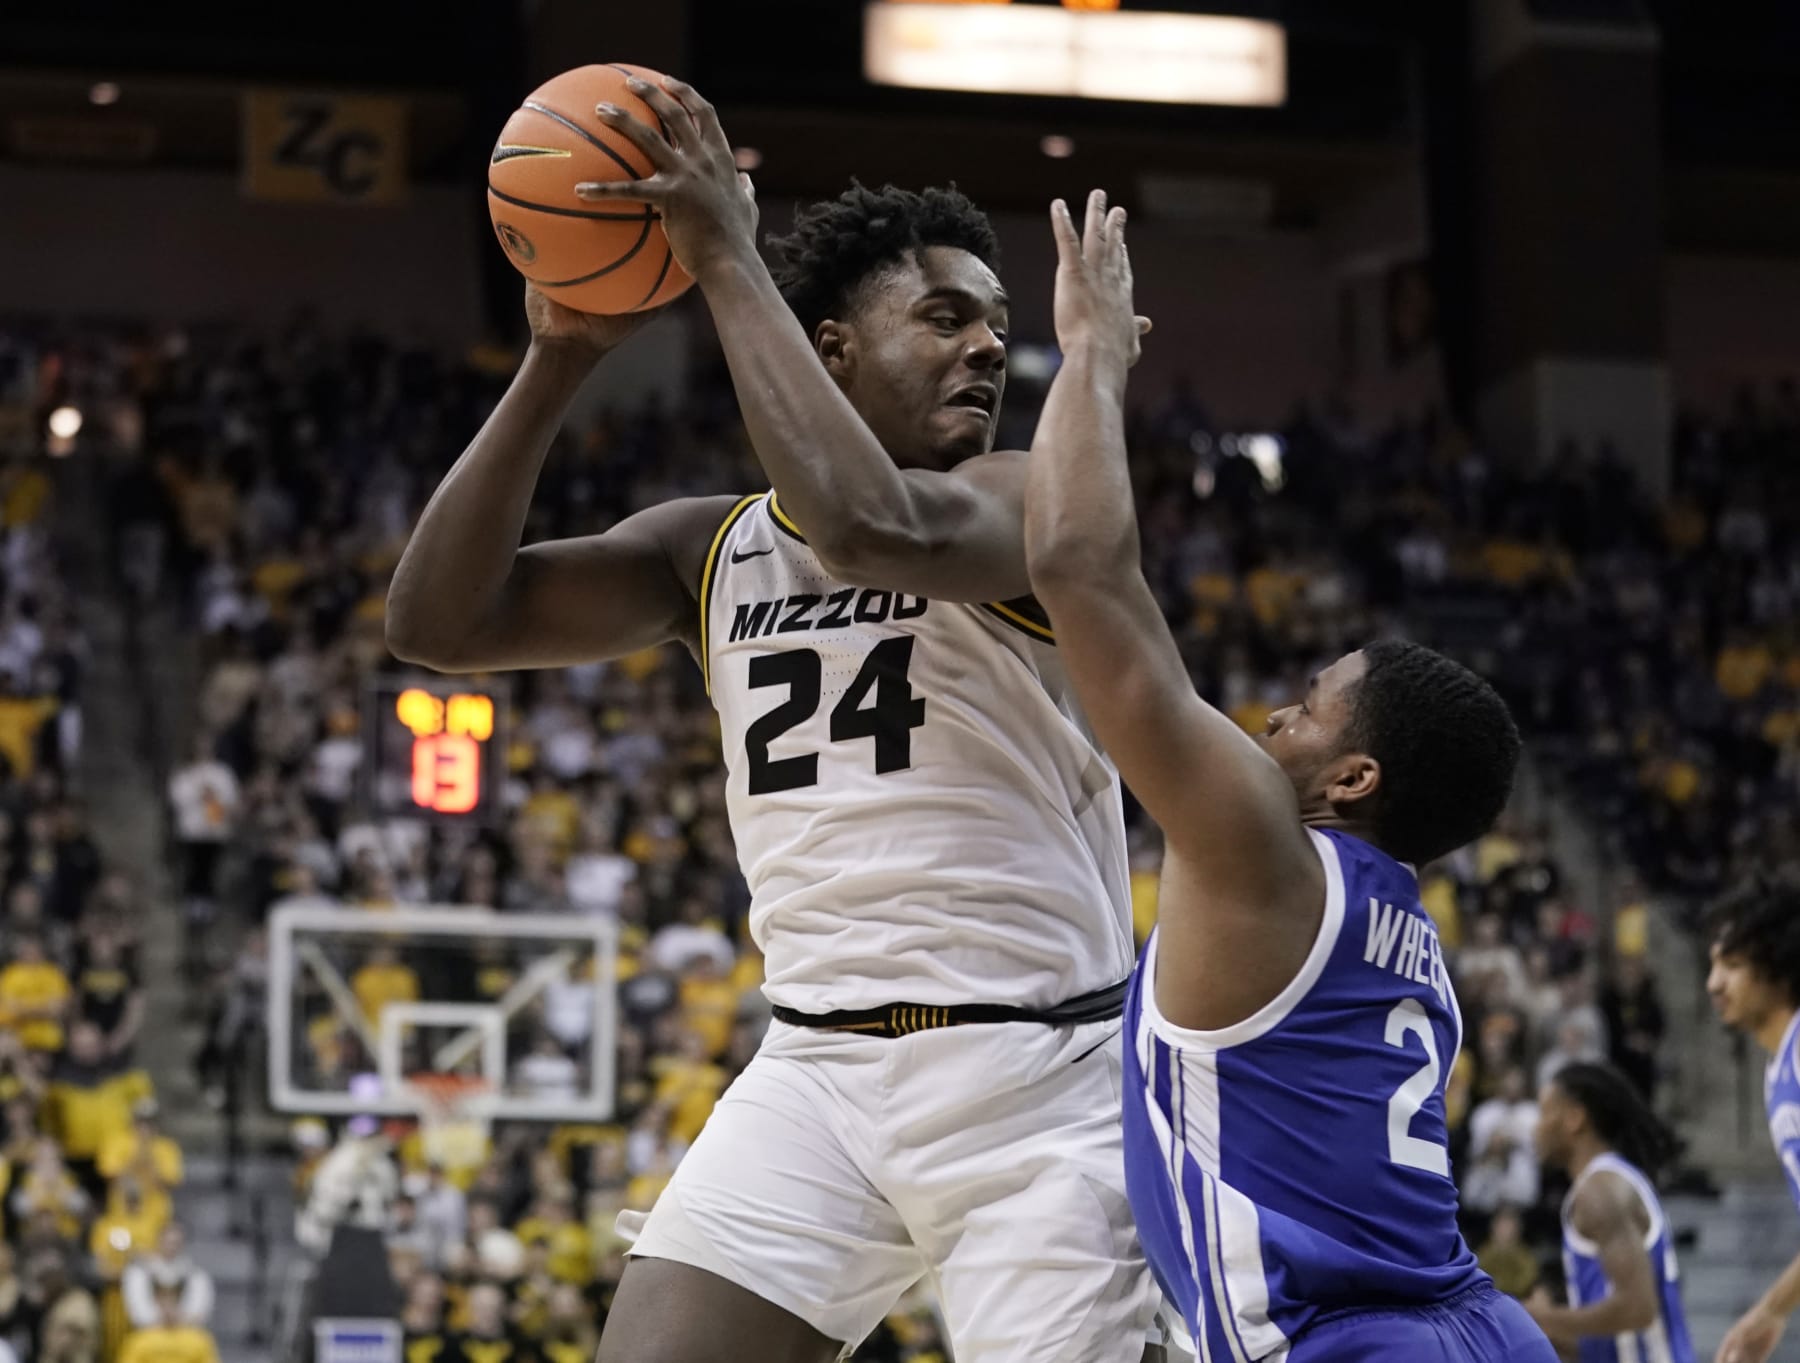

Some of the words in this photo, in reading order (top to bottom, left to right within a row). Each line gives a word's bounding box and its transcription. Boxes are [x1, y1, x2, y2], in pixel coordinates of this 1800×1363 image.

[729, 587, 928, 643] MIZZOU
[745, 634, 926, 796] 24
[1384, 998, 1449, 1177] 2
